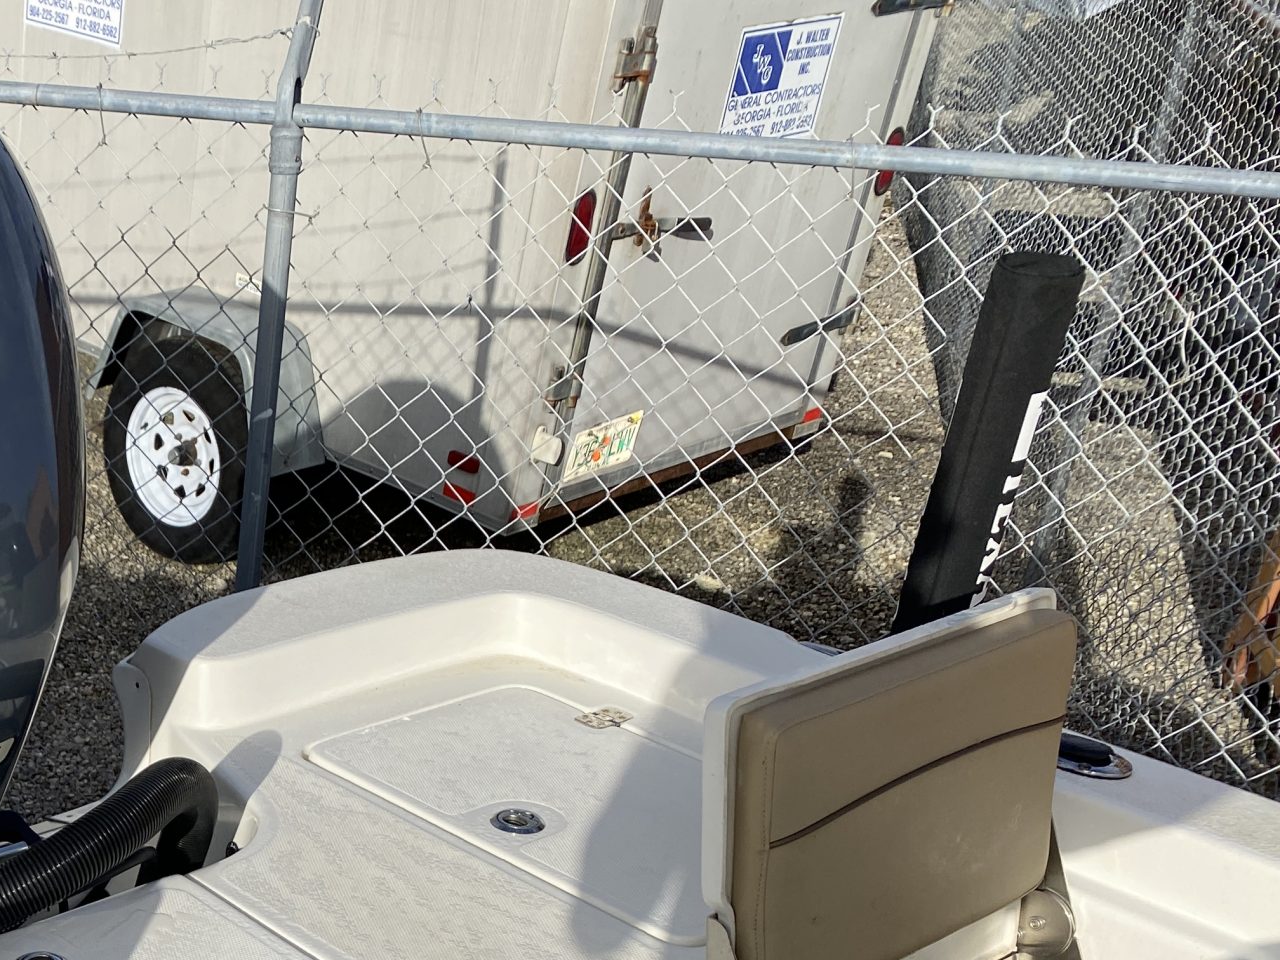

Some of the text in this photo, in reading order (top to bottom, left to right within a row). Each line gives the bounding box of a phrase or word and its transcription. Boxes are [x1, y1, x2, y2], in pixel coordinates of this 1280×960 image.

[78, 3, 112, 21] FLORIDA
[805, 28, 830, 44] WALTER
[786, 44, 832, 62] CONSTRUCTION
[764, 83, 822, 105] CONTRACTORS
